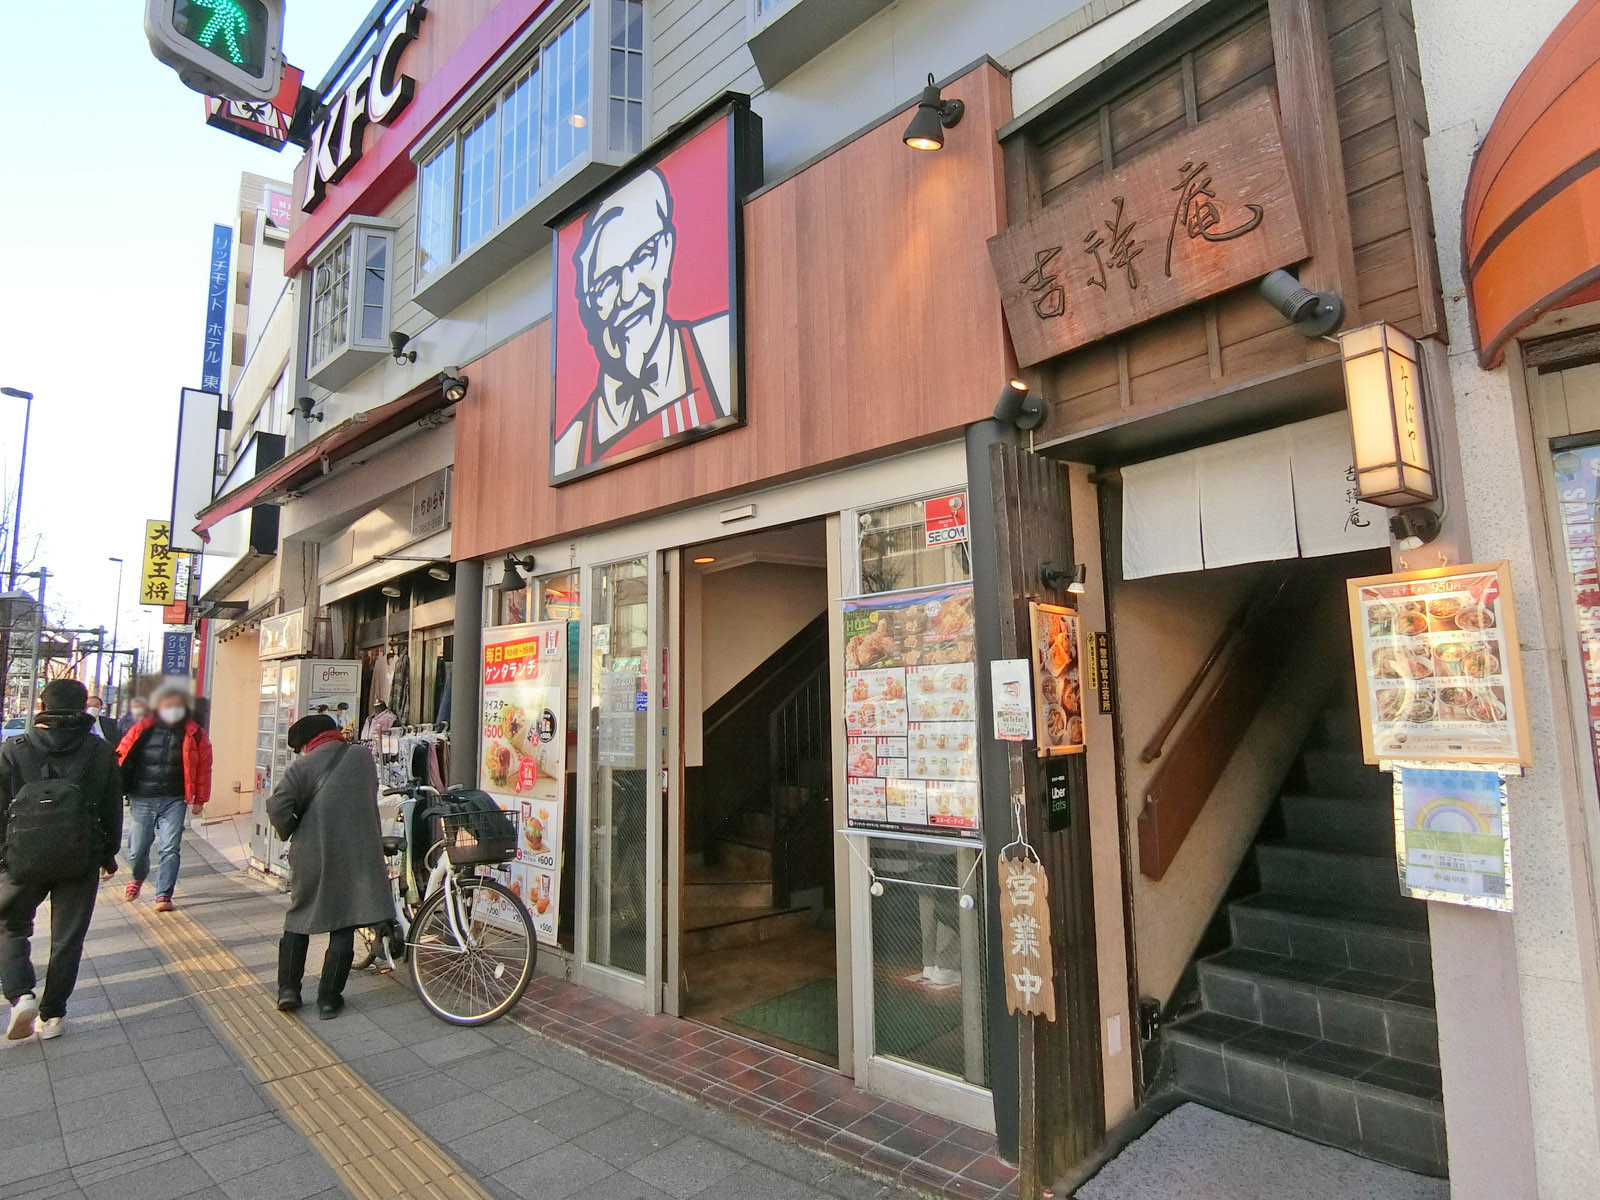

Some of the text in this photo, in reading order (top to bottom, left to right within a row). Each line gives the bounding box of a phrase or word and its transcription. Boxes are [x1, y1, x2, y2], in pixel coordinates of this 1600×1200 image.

[302, 8, 416, 212] KFC
[1020, 161, 1264, 319] 吉祥庵
[203, 236, 228, 389] リッチモンド ホテル 東
[1343, 465, 1370, 532] 吉祥庵
[1563, 488, 1592, 535] SALE
[928, 526, 965, 543] SECOM
[145, 524, 171, 601] 大阪王将
[1570, 548, 1599, 593] SALE
[167, 635, 177, 668] クリニック
[486, 646, 503, 664] 毎日
[485, 659, 537, 681] ケンタランチ
[484, 700, 509, 711] ツイスター
[484, 725, 504, 738] ¥500
[1051, 787, 1065, 800] Uber
[1053, 800, 1067, 811] Eats
[538, 855, 554, 866] ¥600
[1005, 866, 1043, 1005] 営業中
